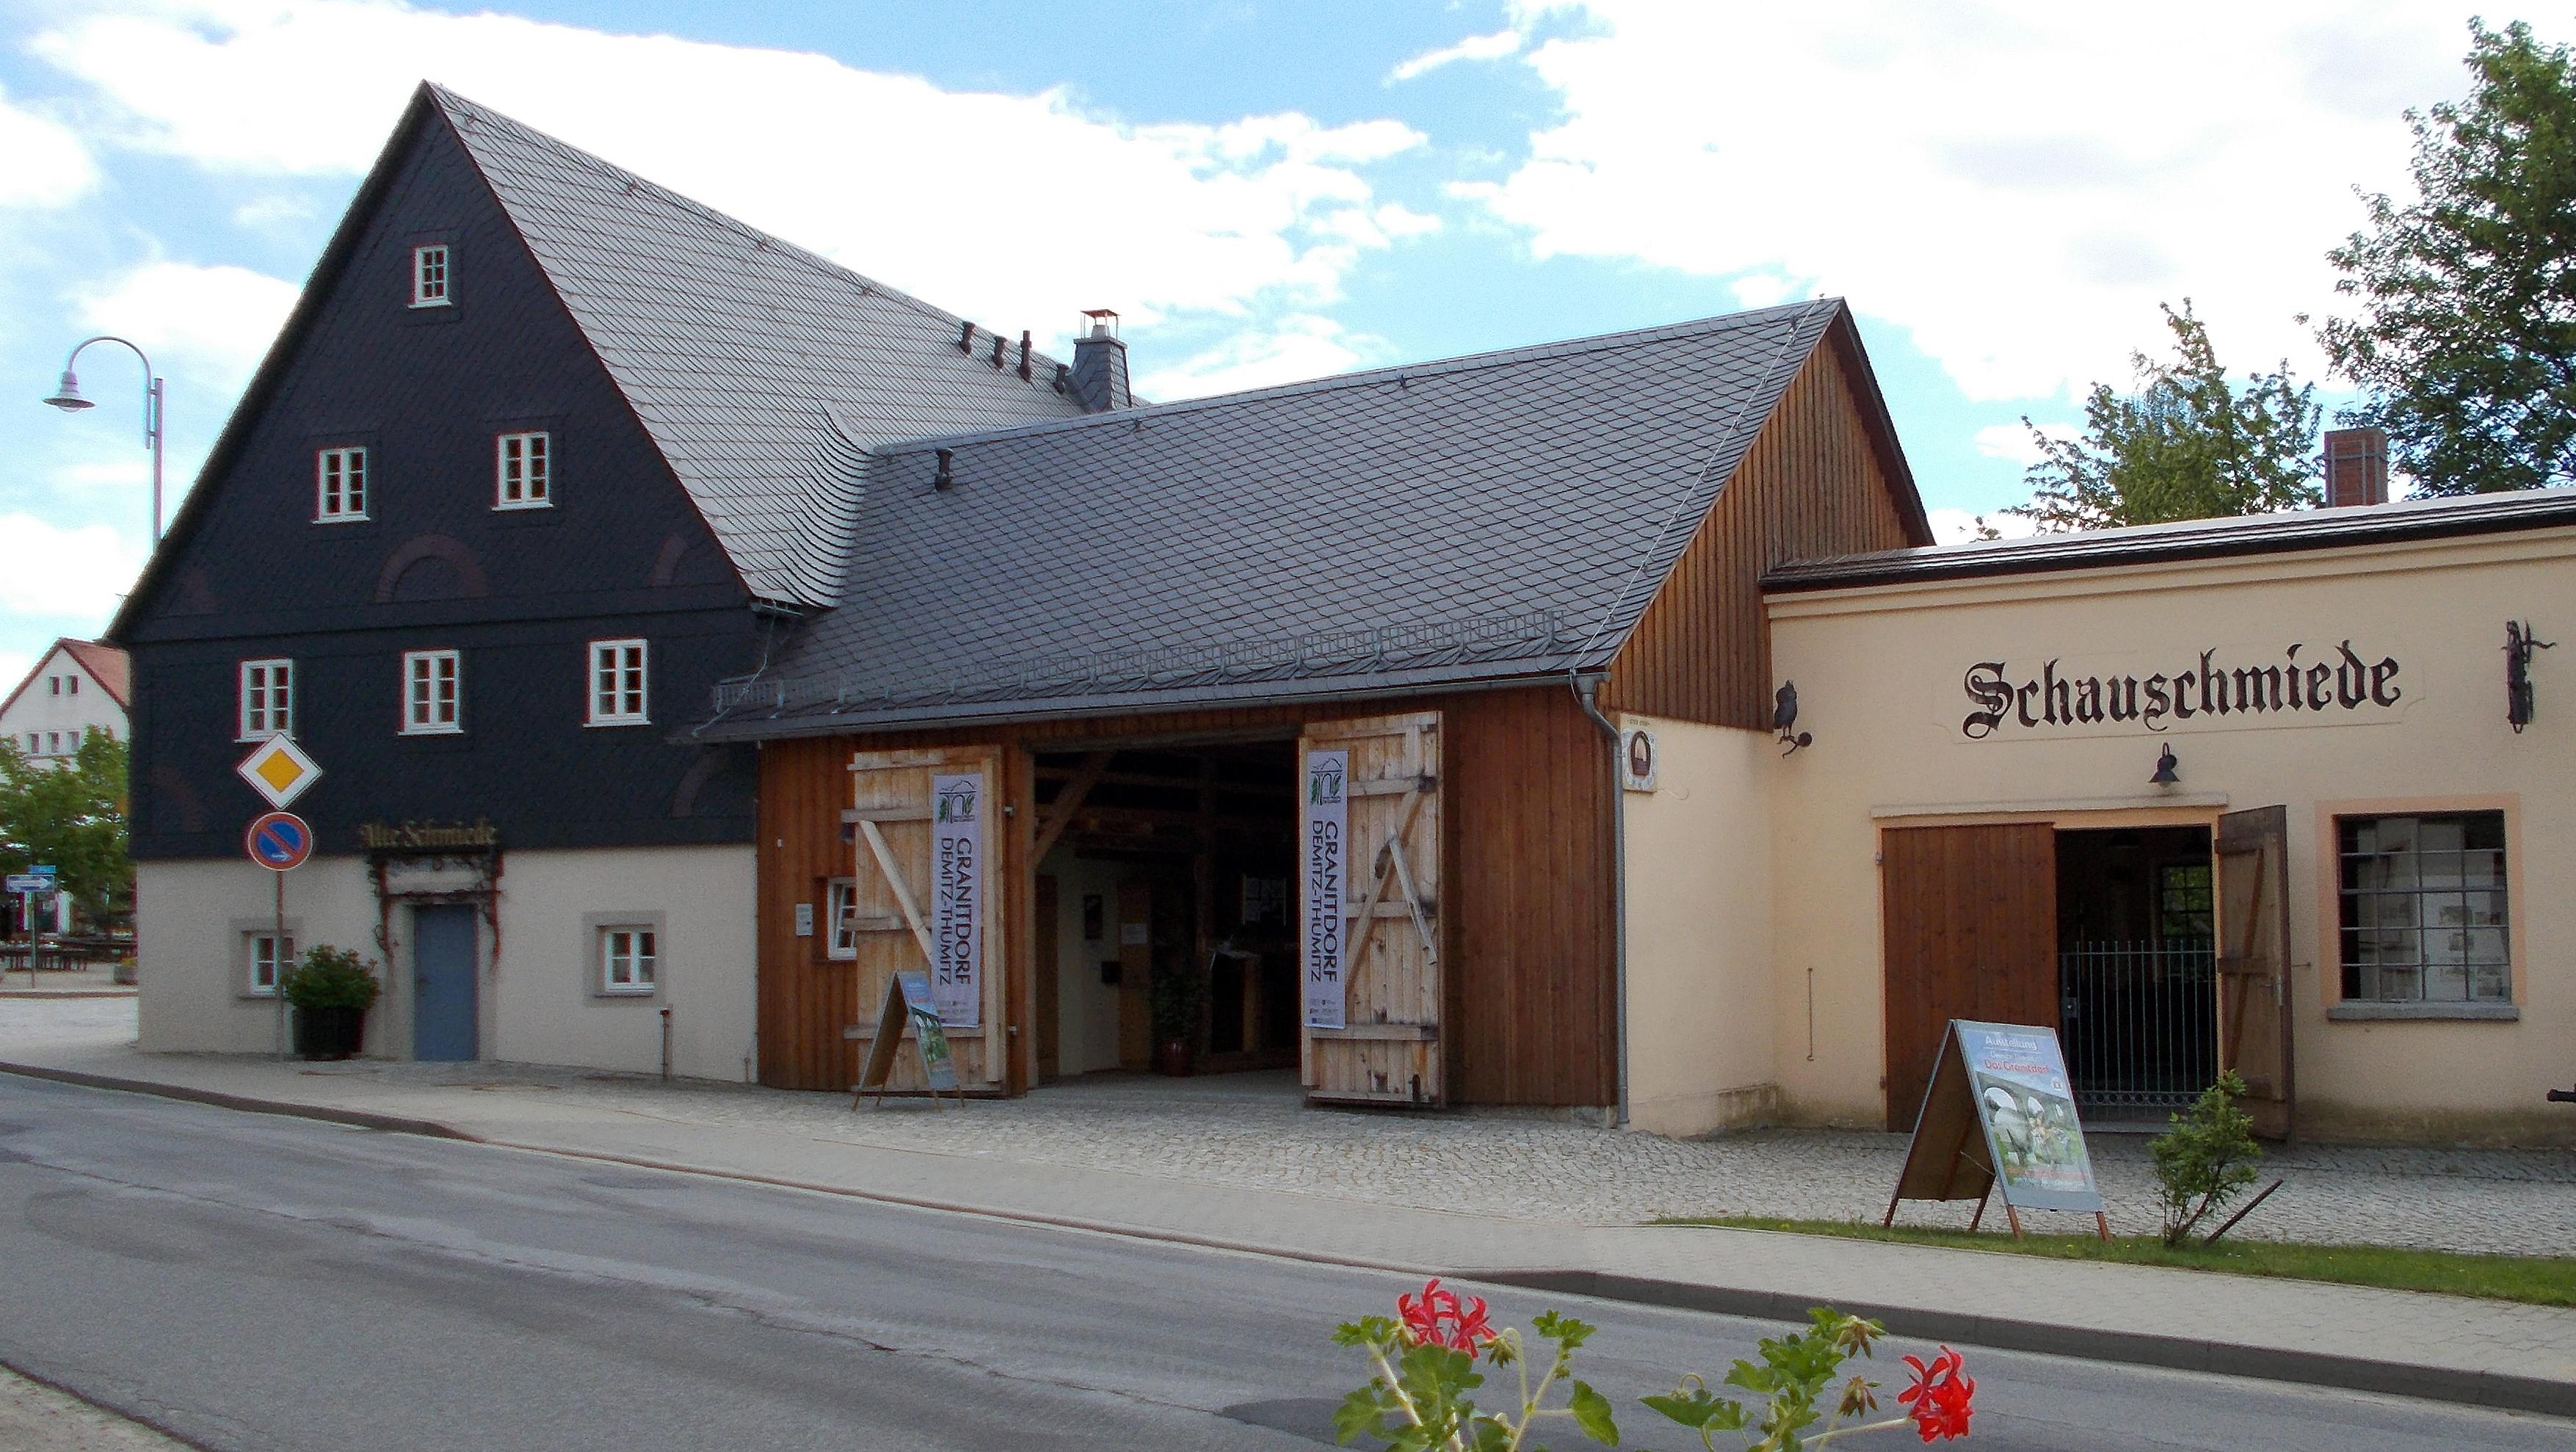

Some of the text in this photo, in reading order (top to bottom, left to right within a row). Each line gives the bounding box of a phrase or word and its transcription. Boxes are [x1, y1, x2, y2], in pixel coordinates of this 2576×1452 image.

[1962, 640, 2401, 739] Schauschmiede
[940, 838, 954, 985] DEMITZ-THUMITZ
[956, 838, 973, 984] GRANITDORF
[1311, 820, 1323, 982] DEMITZ-THUMITZ
[1324, 821, 1338, 982] GRANITDORF
[1985, 1036, 2037, 1050] Ausstellung
